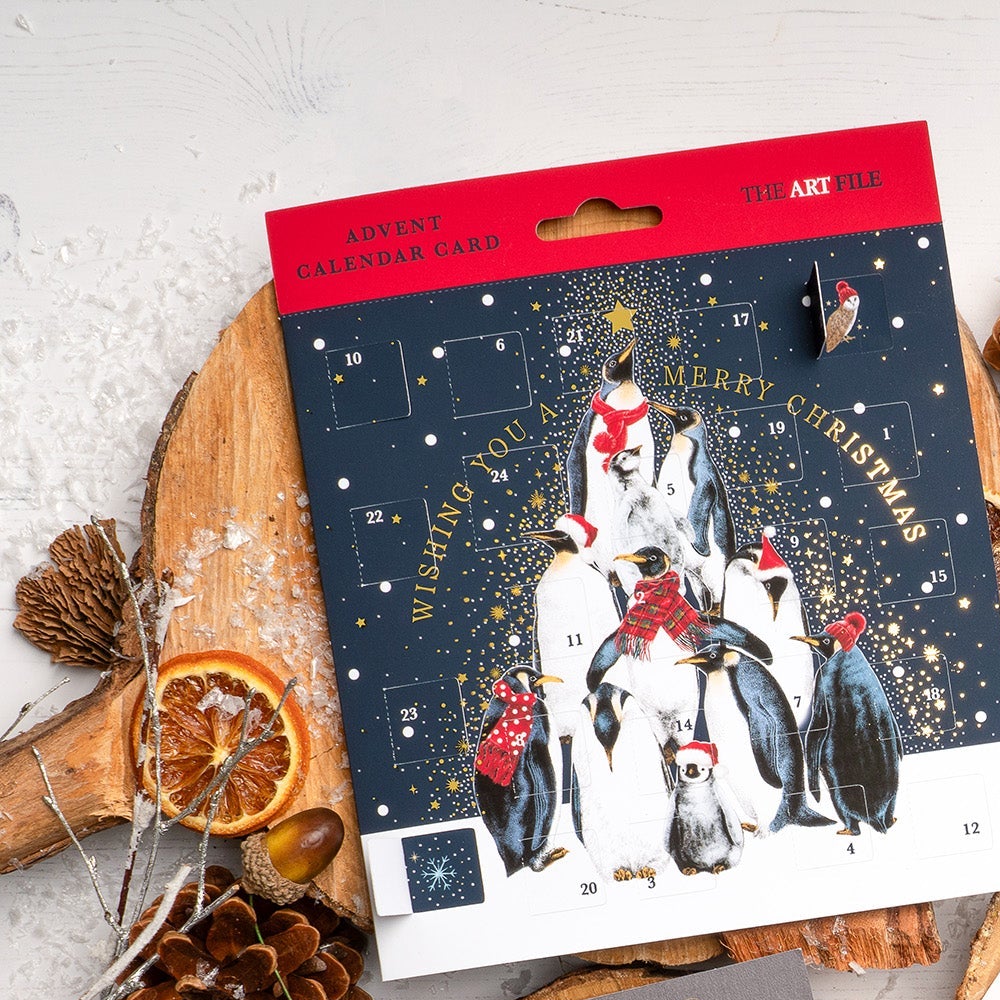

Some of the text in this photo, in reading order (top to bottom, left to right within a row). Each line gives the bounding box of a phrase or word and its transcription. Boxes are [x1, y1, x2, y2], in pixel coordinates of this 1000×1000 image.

[740, 170, 883, 204] THE ART FILE
[345, 215, 442, 245] ADVENT
[296, 234, 501, 280] CALENDAR CARD
[732, 313, 750, 327] 17
[566, 329, 583, 343] 21
[495, 338, 506, 352] 6
[345, 352, 362, 366] 10
[767, 421, 786, 435] 19
[882, 428, 891, 440] 1
[490, 469, 509, 483] 24
[411, 365, 927, 624] WISHING YOU A MERRY CHRISTMAS
[667, 483, 676, 496] 5
[366, 510, 384, 524] 22
[790, 535, 800, 548] 9
[930, 569, 948, 583] 15
[636, 591, 646, 604] 2
[566, 634, 583, 647] 11
[924, 687, 941, 701] 18
[793, 695, 802, 708] 7
[400, 707, 418, 721] 23
[675, 719, 693, 732] 14
[515, 733, 525, 748] 8
[963, 822, 981, 836] 12
[846, 842, 856, 855] 4
[580, 882, 598, 896] 20
[647, 876, 657, 890] 3
